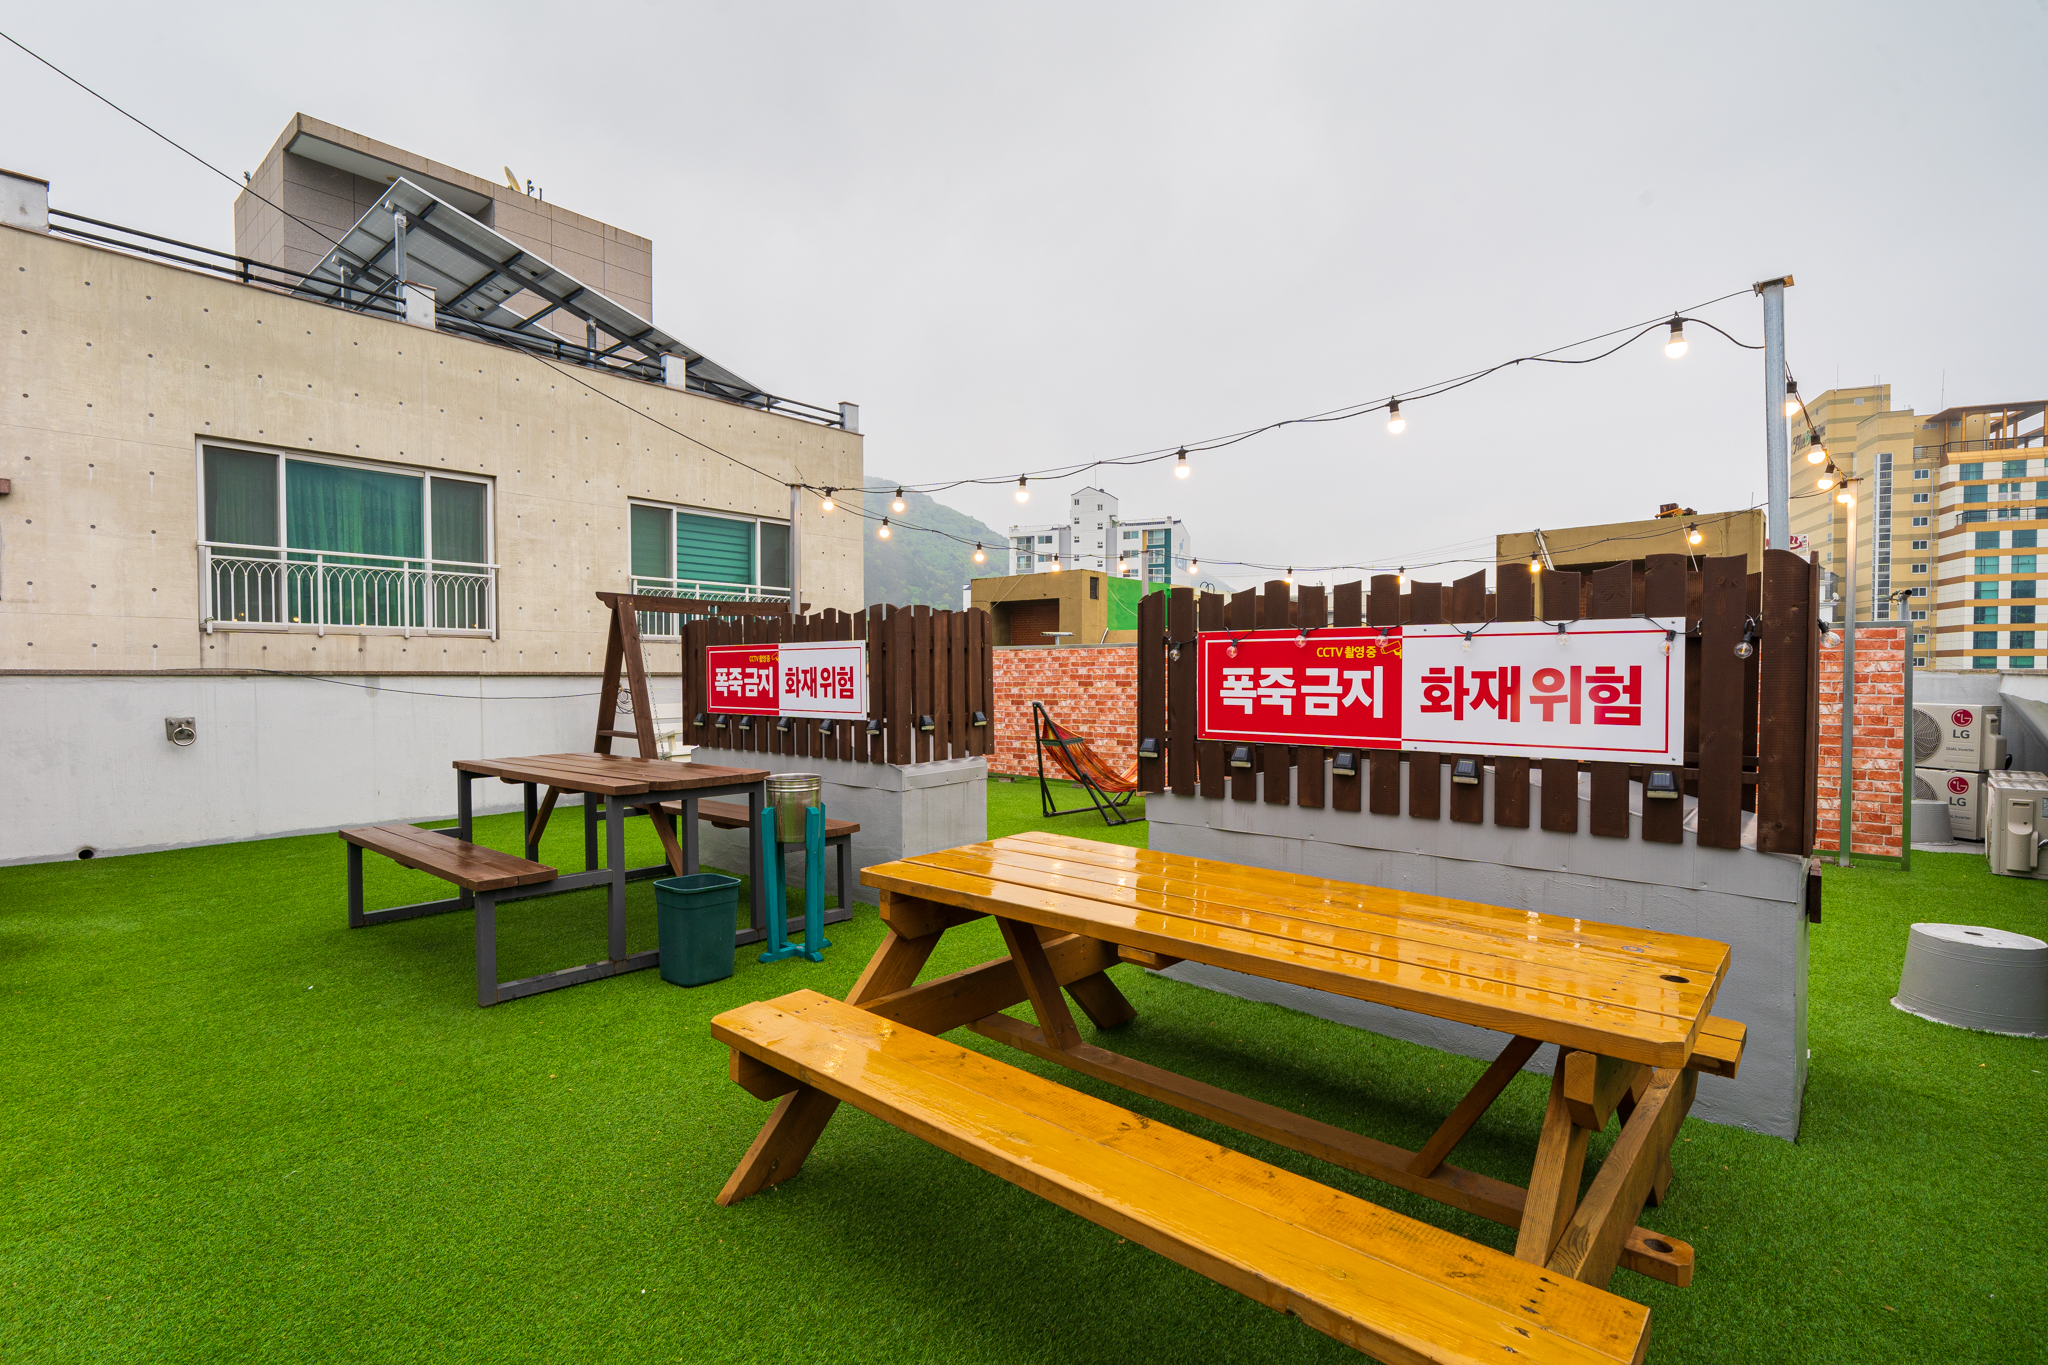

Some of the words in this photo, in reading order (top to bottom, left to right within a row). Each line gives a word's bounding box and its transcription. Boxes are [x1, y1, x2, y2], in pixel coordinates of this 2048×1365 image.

[1316, 647, 1343, 658] CCTV
[1953, 729, 1970, 739] LG
[1949, 796, 1967, 806] LG
